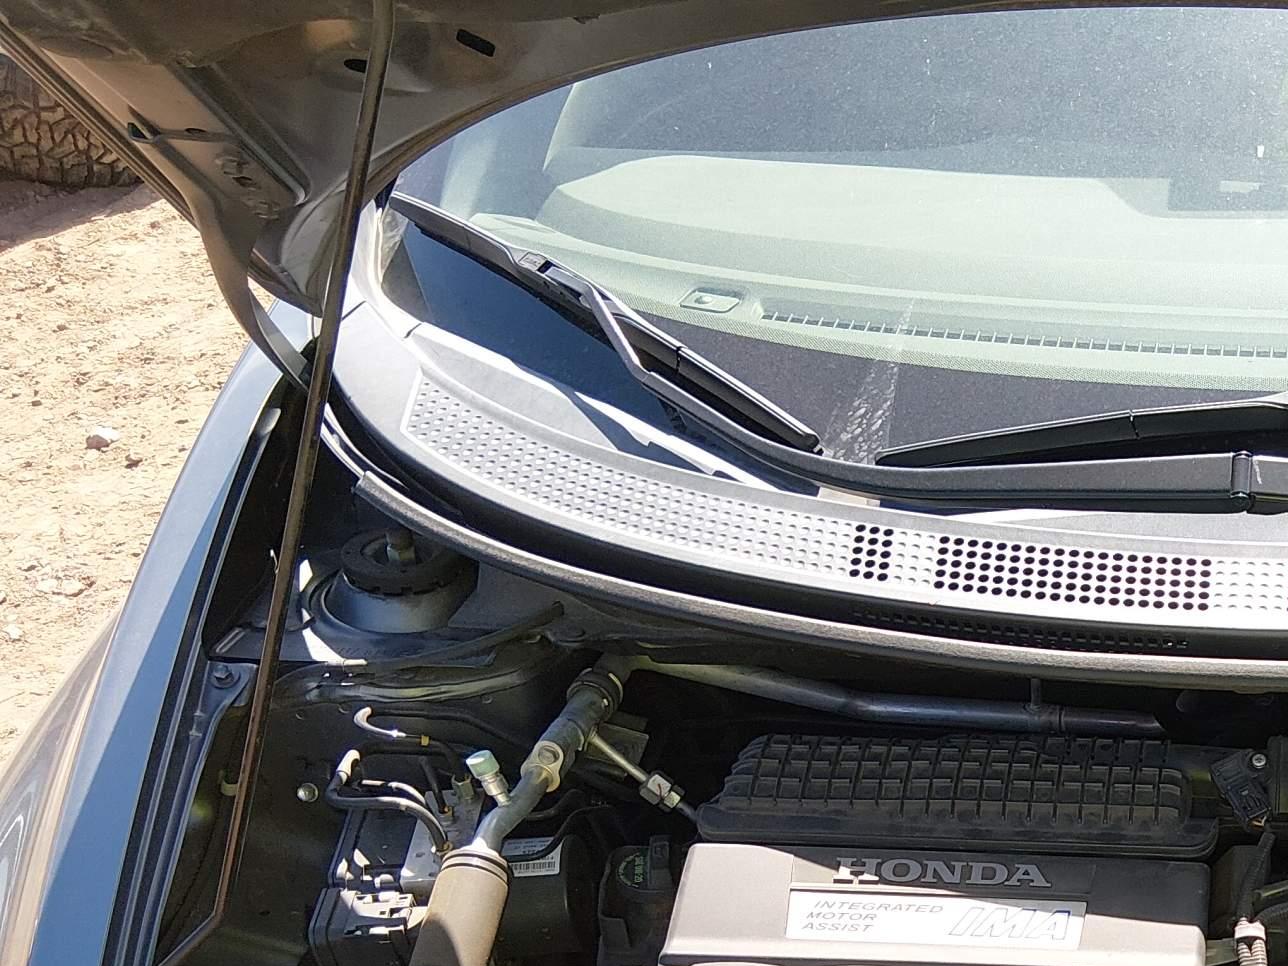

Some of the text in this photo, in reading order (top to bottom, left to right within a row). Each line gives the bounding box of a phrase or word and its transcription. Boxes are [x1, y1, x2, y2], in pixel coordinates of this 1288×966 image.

[832, 856, 1052, 888] HONDA
[813, 900, 943, 914] INTEGRATED
[805, 911, 878, 922] MOTOR
[948, 905, 1072, 941] IMA
[801, 922, 875, 933] ASSIST
